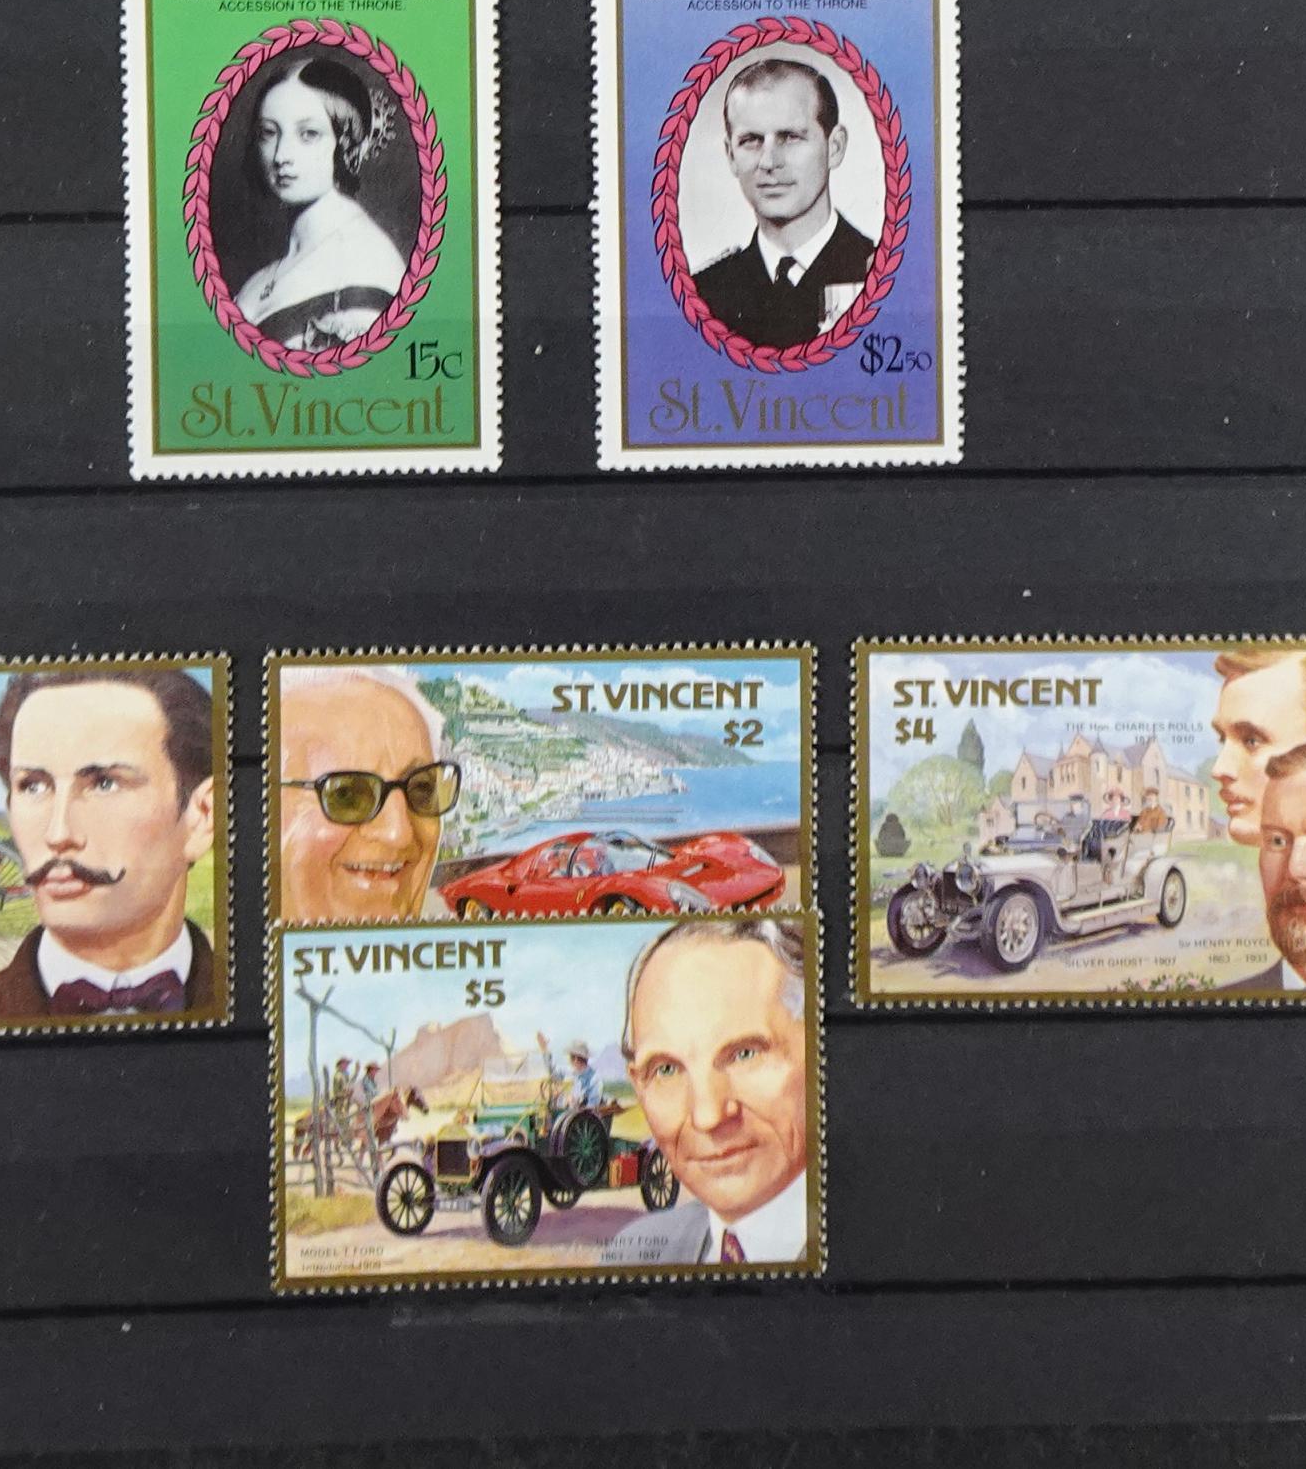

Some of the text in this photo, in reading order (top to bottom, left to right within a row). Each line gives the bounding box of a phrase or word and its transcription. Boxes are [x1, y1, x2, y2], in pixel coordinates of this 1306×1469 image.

[218, 0, 295, 12] ACCESSION
[298, 0, 317, 11] TO
[320, 0, 345, 11] THE
[687, 0, 762, 11] ACCESSION
[766, 0, 784, 10] TO
[722, 718, 765, 747] $2
[895, 716, 937, 745] $4
[464, 978, 507, 1008] $5
